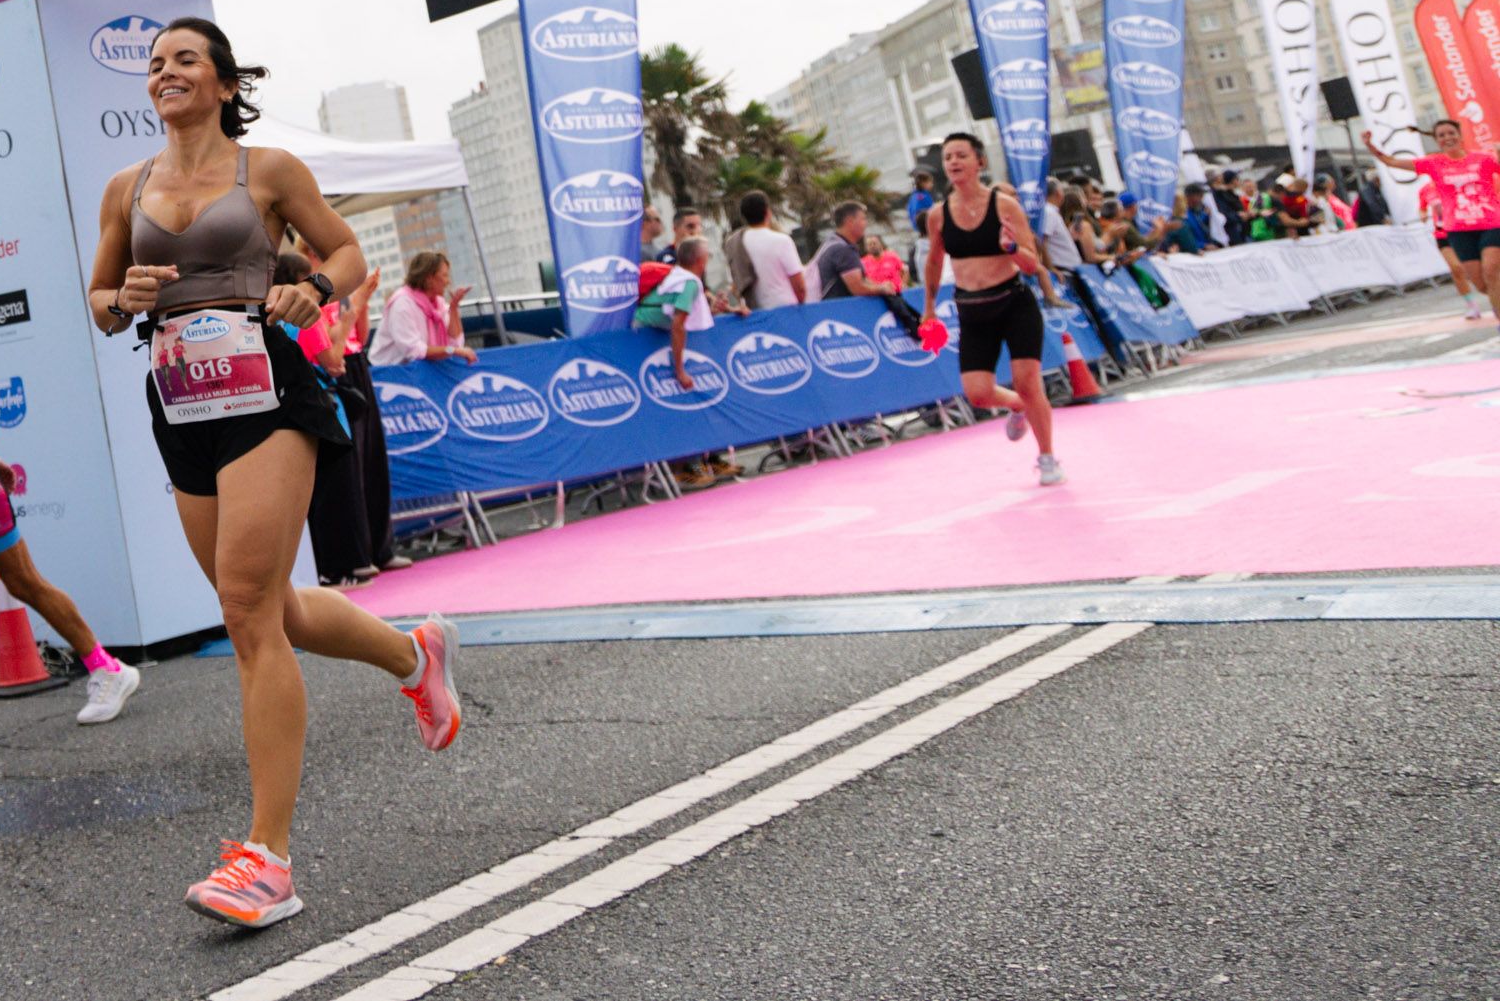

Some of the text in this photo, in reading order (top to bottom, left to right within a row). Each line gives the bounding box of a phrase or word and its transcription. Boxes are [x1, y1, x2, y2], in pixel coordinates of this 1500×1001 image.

[1431, 13, 1476, 102] Santander
[189, 357, 233, 381] 016
[177, 405, 212, 417] OYSHO
[456, 399, 544, 428] ASTURIANA
[557, 384, 636, 414] ASTURIANA
